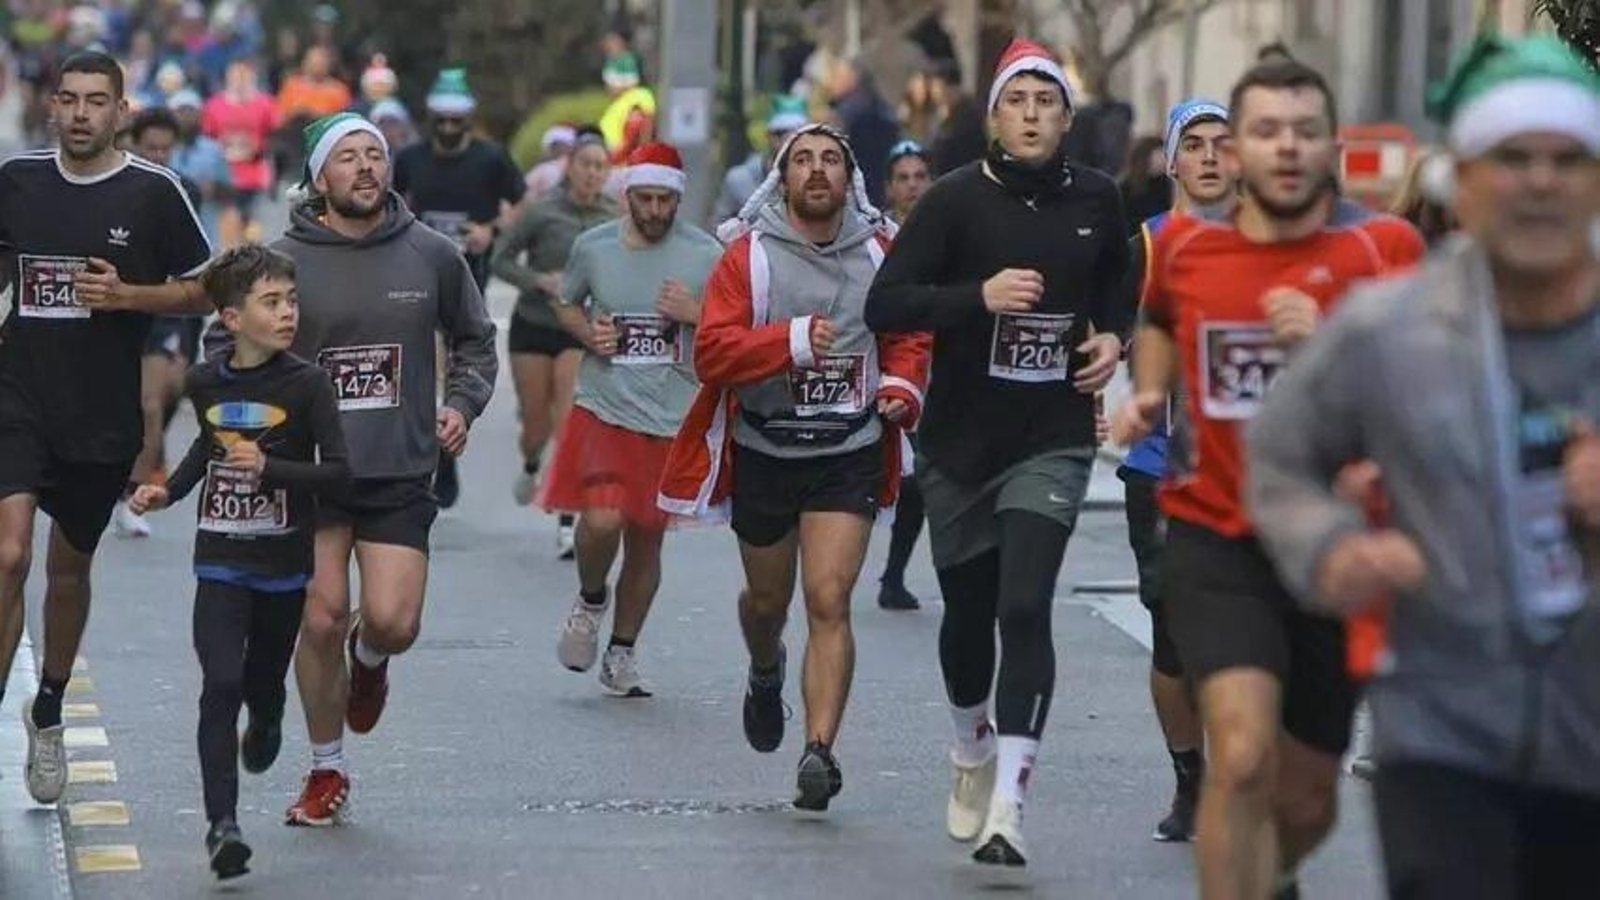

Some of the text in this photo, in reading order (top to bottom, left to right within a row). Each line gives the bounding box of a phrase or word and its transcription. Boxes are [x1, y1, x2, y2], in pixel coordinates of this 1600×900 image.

[627, 337, 666, 356] 280
[1008, 343, 1066, 369] 1204
[334, 373, 387, 398] 1473
[800, 381, 850, 404] 1472
[210, 493, 269, 519] 3012
